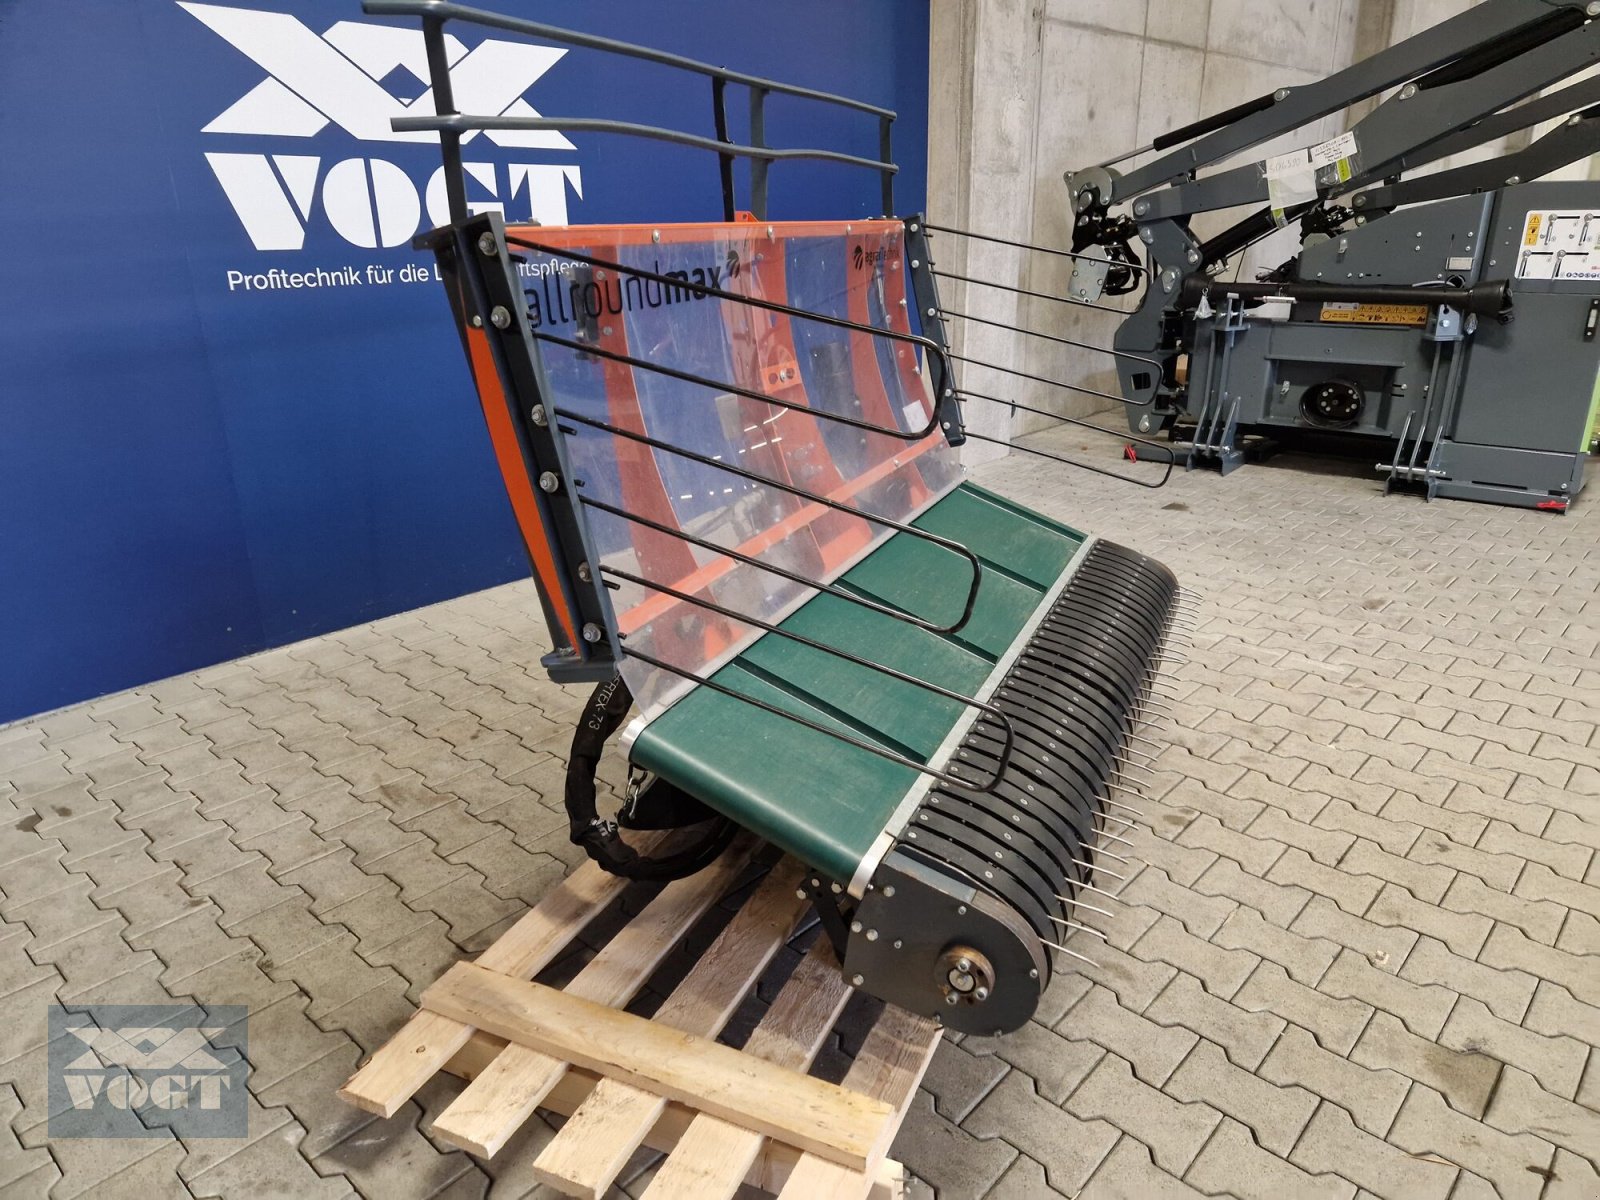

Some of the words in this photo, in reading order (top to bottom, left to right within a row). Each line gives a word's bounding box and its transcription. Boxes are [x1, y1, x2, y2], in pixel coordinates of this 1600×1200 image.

[204, 152, 584, 251] VOGT
[227, 266, 362, 290] Profitechnik
[366, 264, 395, 284] für
[400, 263, 429, 283] die
[523, 260, 722, 329] allroundmax
